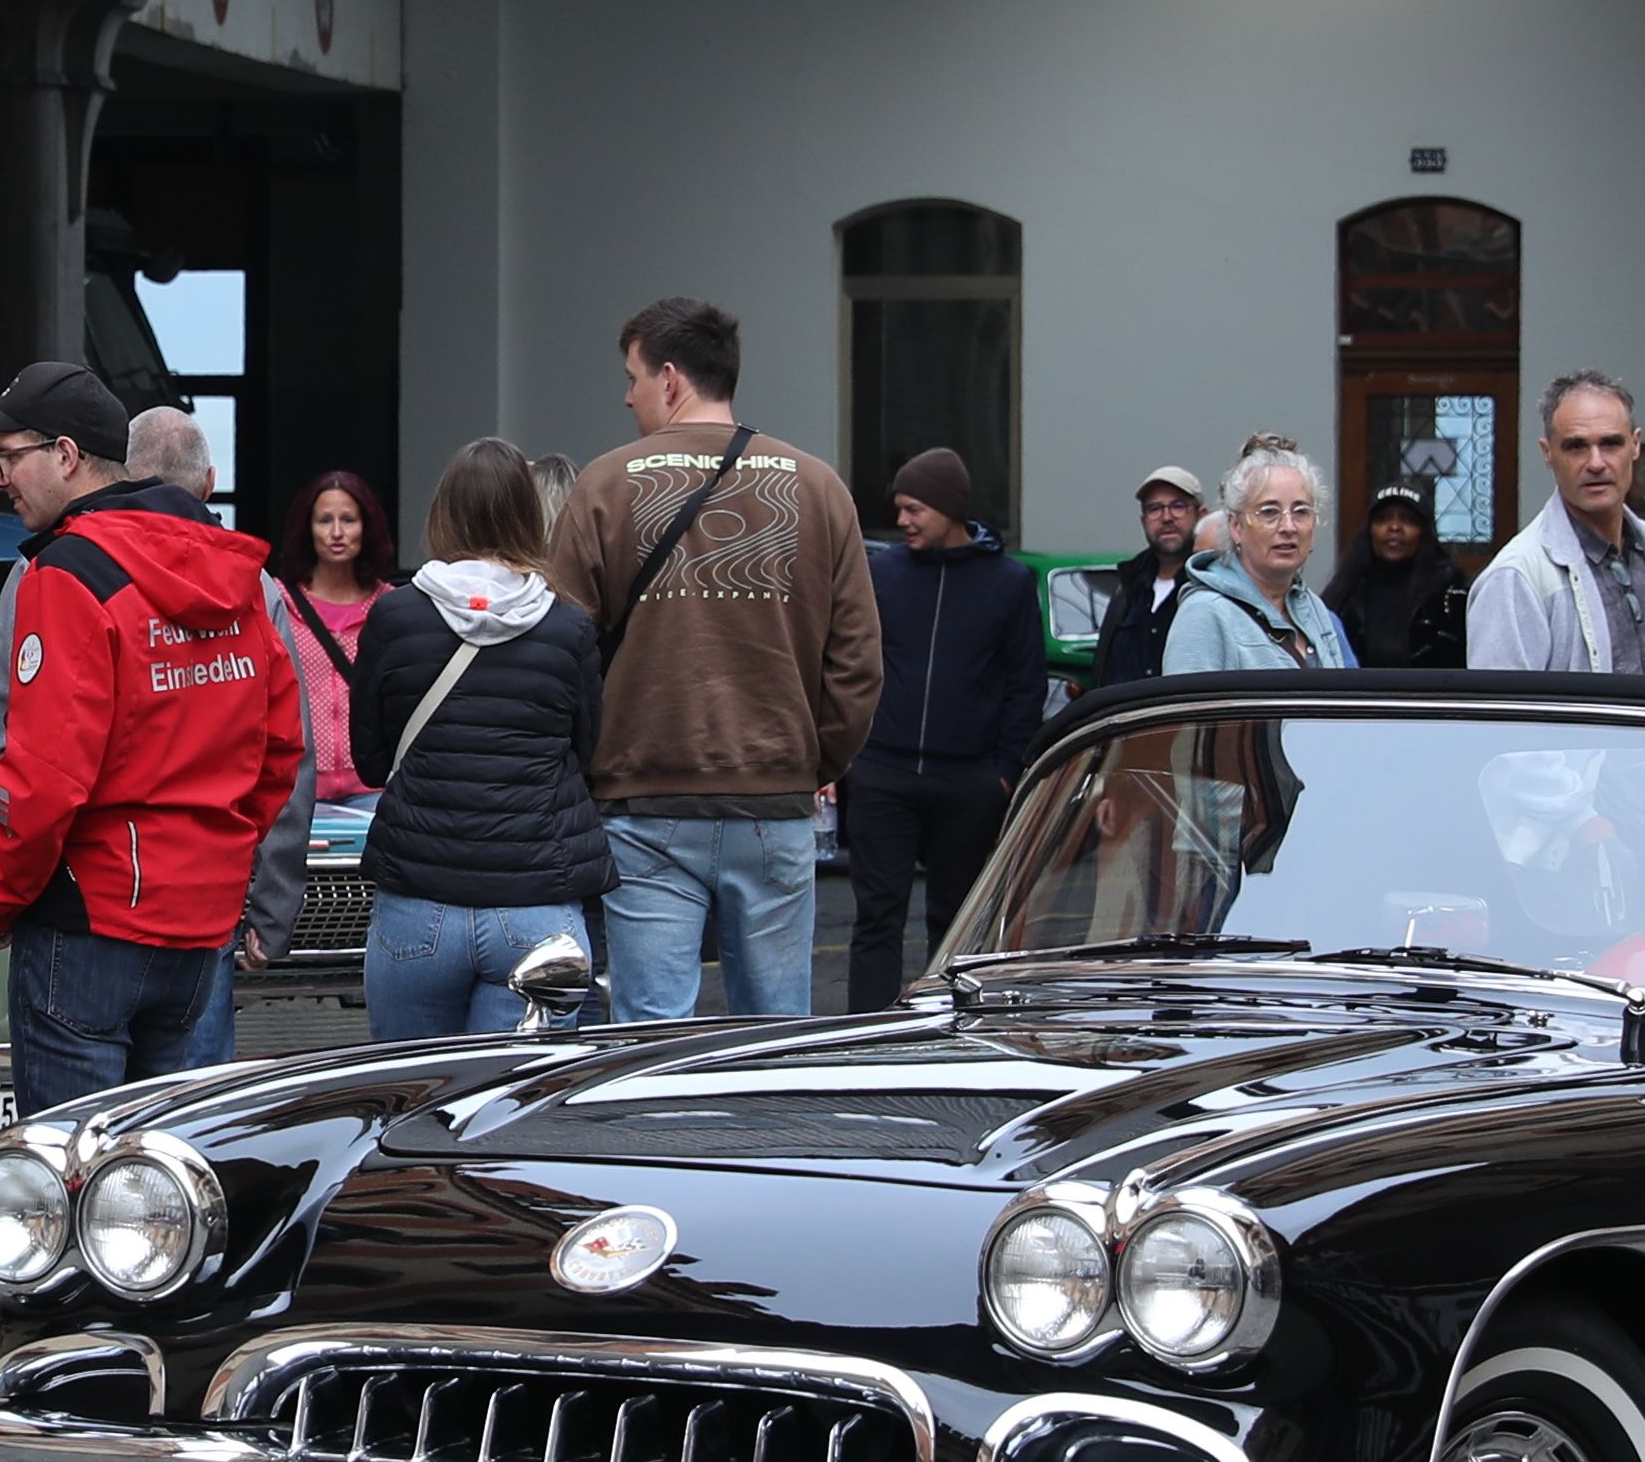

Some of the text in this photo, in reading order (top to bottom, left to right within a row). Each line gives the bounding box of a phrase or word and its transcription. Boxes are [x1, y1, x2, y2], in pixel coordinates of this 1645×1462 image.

[626, 453, 797, 473] SCENIC HIKE
[151, 652, 256, 692] Einsiedeln
